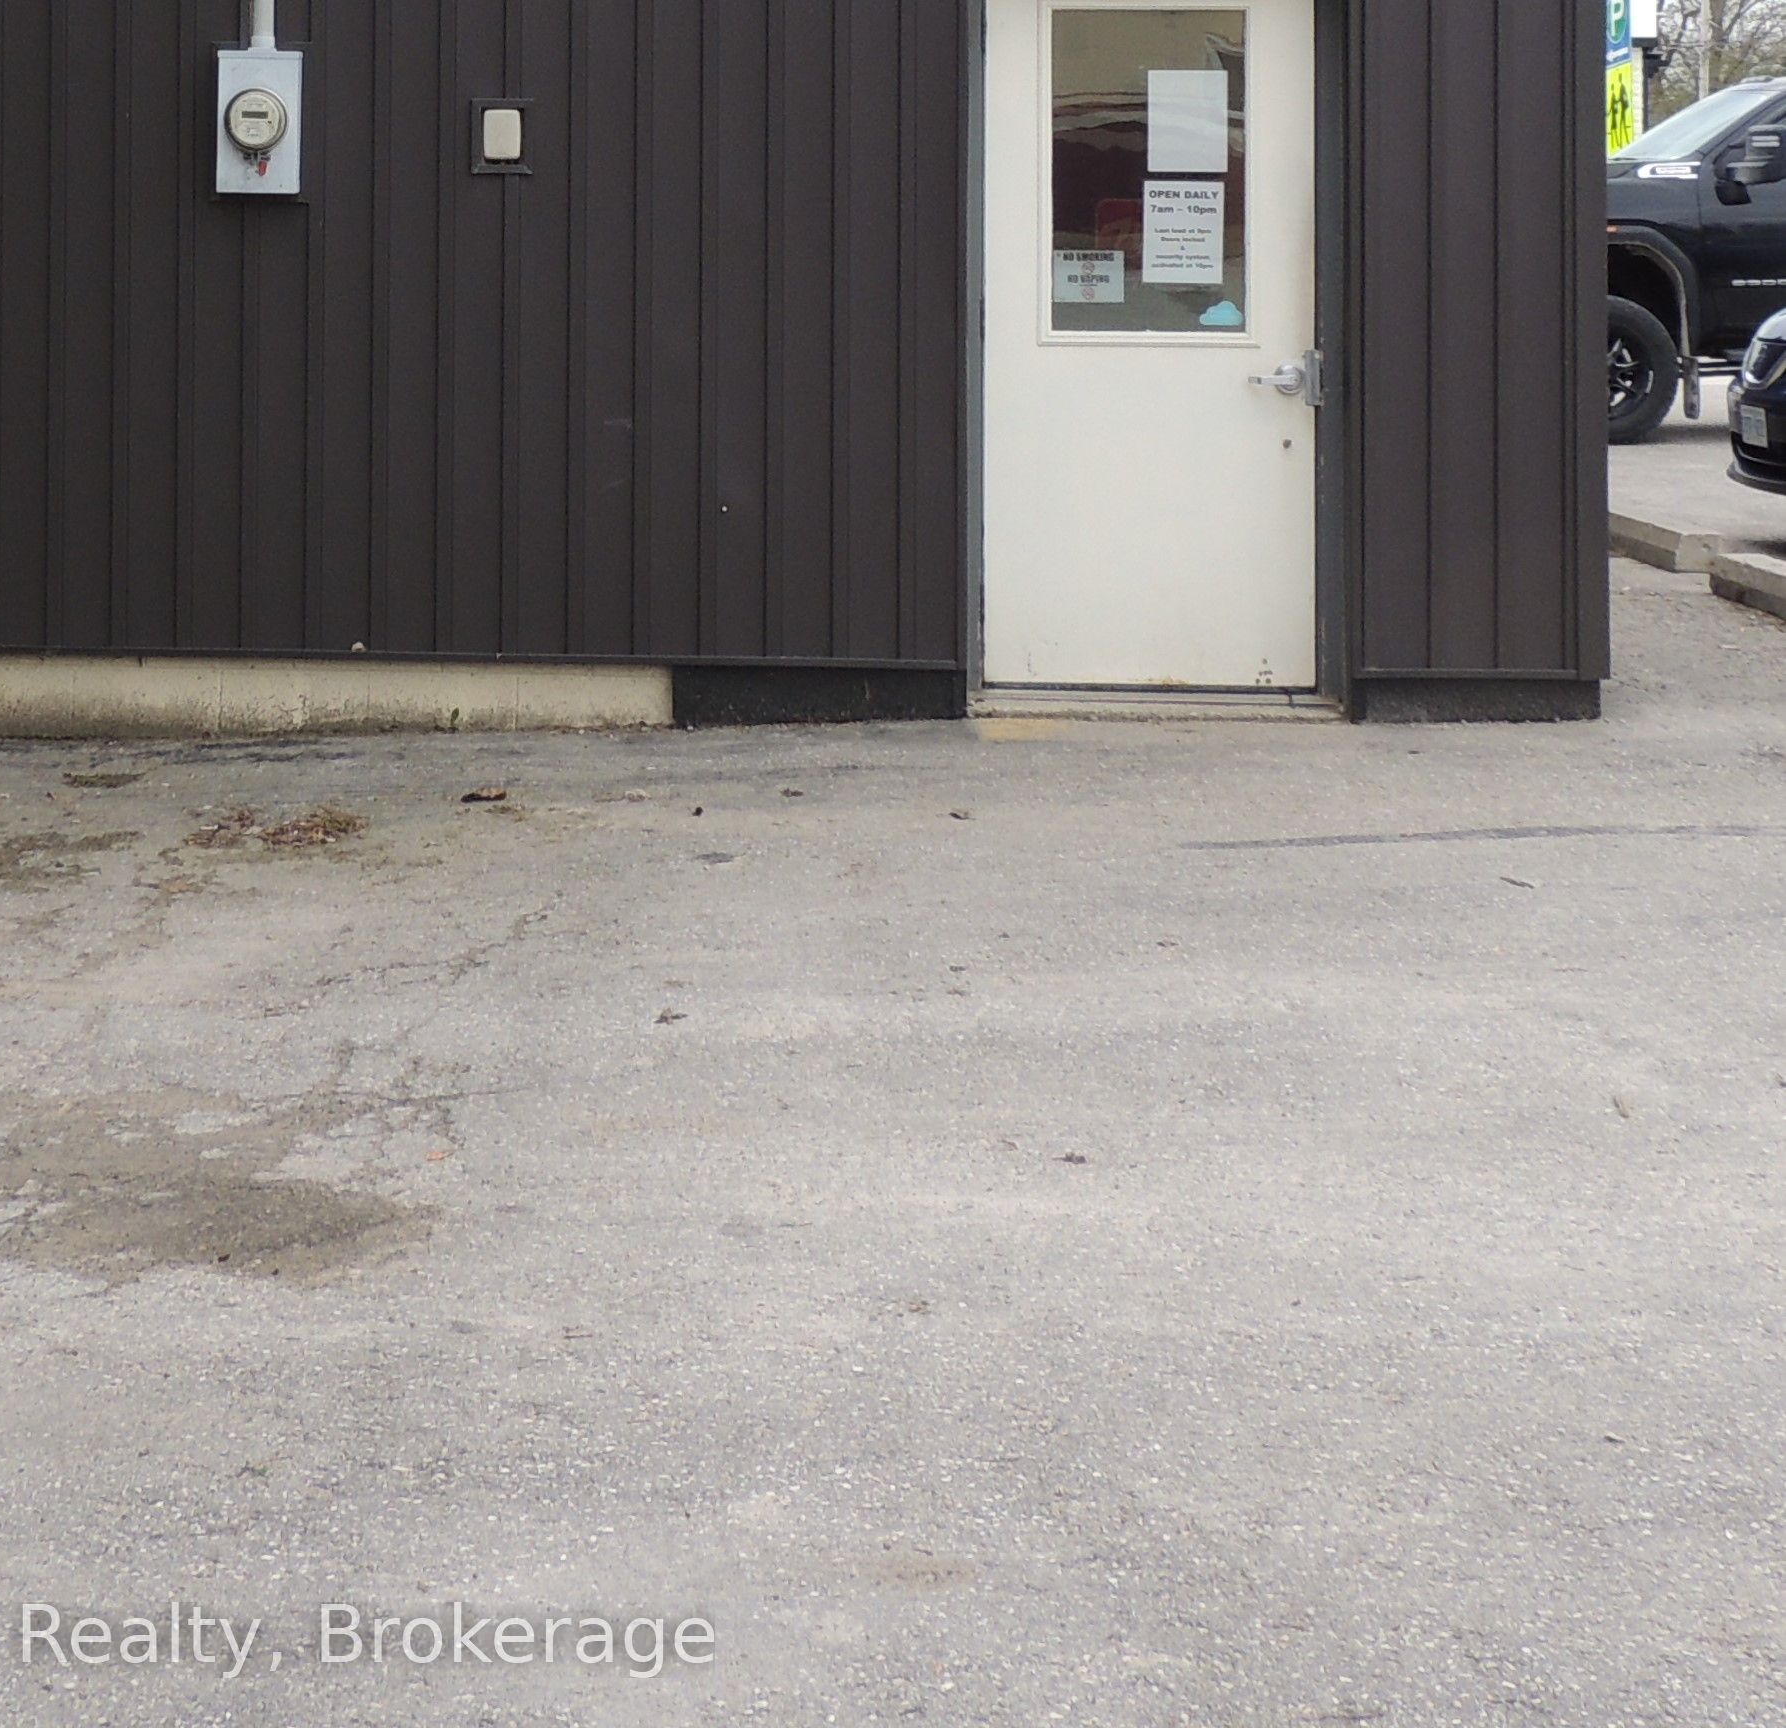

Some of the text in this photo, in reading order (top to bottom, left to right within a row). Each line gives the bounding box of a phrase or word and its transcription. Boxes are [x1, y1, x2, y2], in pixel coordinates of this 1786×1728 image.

[1149, 190, 1219, 200] OPEN DAILY
[1150, 204, 1174, 214] 7am
[1187, 205, 1217, 215] 10pm
[1063, 252, 1114, 261] NO SMOKING
[1067, 274, 1110, 283] NO VAPING
